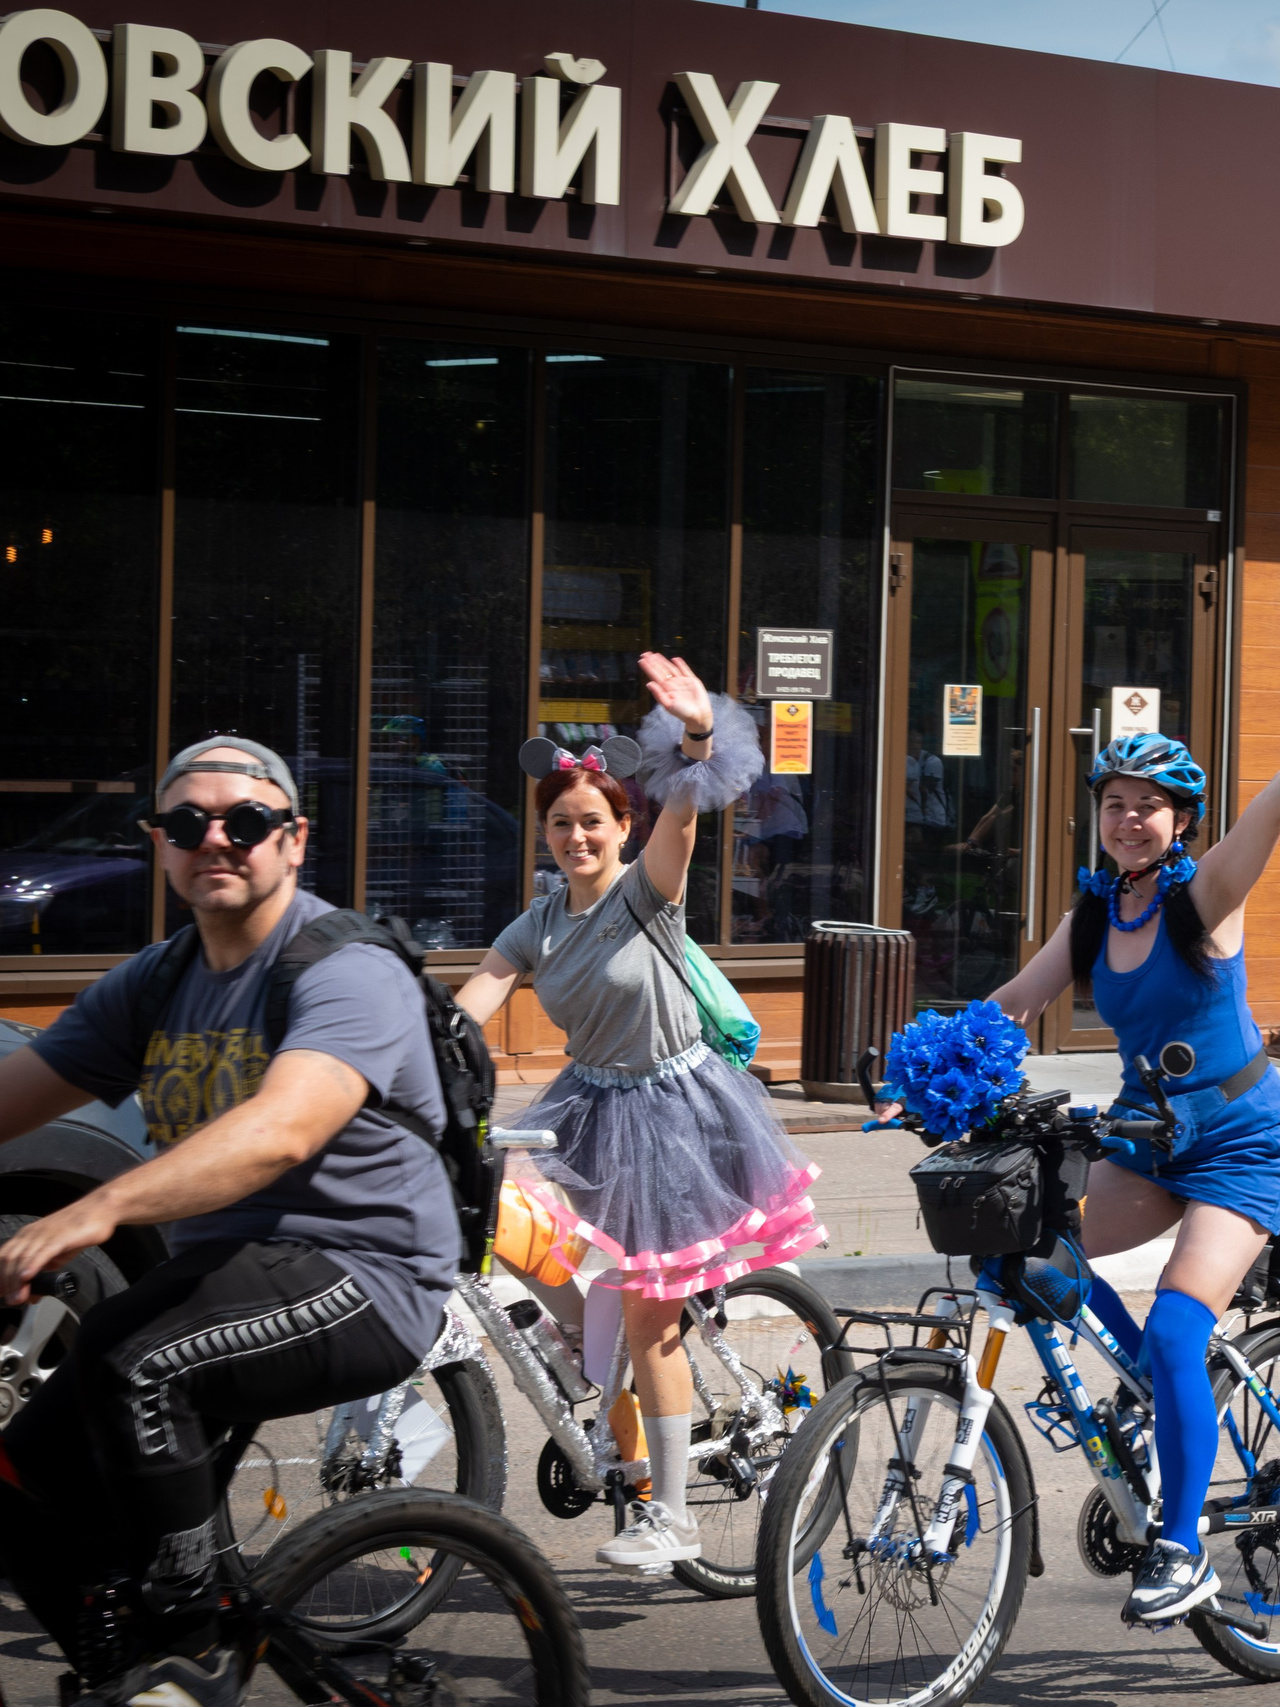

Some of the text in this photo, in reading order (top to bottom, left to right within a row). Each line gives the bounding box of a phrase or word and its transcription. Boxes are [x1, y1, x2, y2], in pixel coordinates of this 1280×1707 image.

[0, 9, 1026, 248] ОВСКИЙ ХЛЕБ
[1250, 1510, 1278, 1523] XTR
[951, 1625, 1000, 1699] STELS
